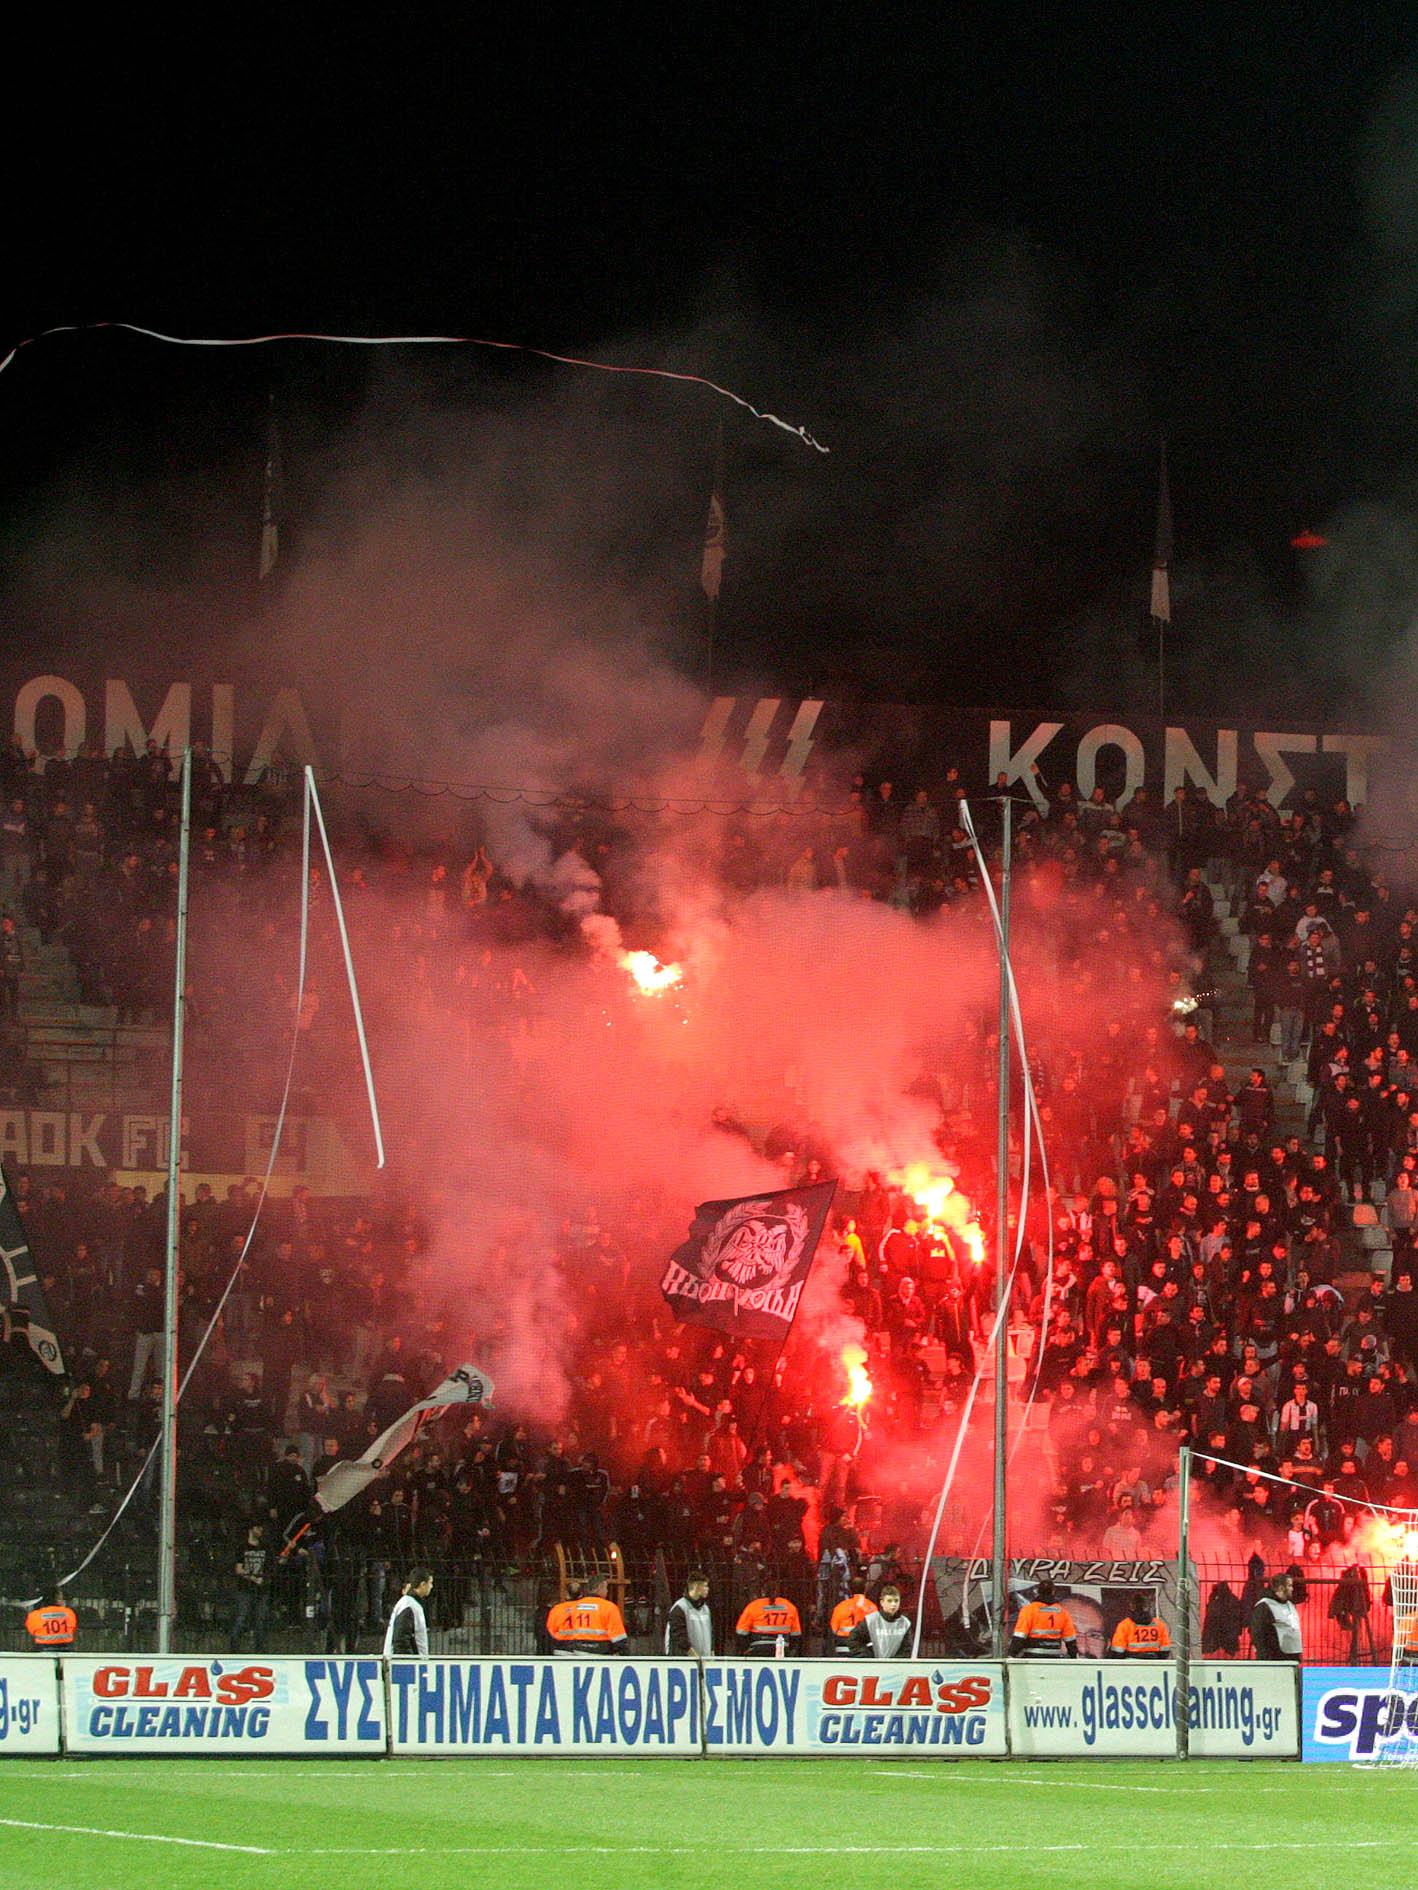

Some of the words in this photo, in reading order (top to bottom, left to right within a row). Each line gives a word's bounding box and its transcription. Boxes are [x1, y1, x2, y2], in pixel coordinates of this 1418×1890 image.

[969, 1557, 1071, 1580] ΔΥΡΑ
[43, 1619, 68, 1634] 101
[763, 1612, 788, 1626] 177
[1133, 1627, 1160, 1643] 129
[1024, 1669, 1282, 1746] www.glassclaning.gr
[89, 1705, 271, 1739] CLEANING
[818, 1714, 987, 1746] CLEANING
